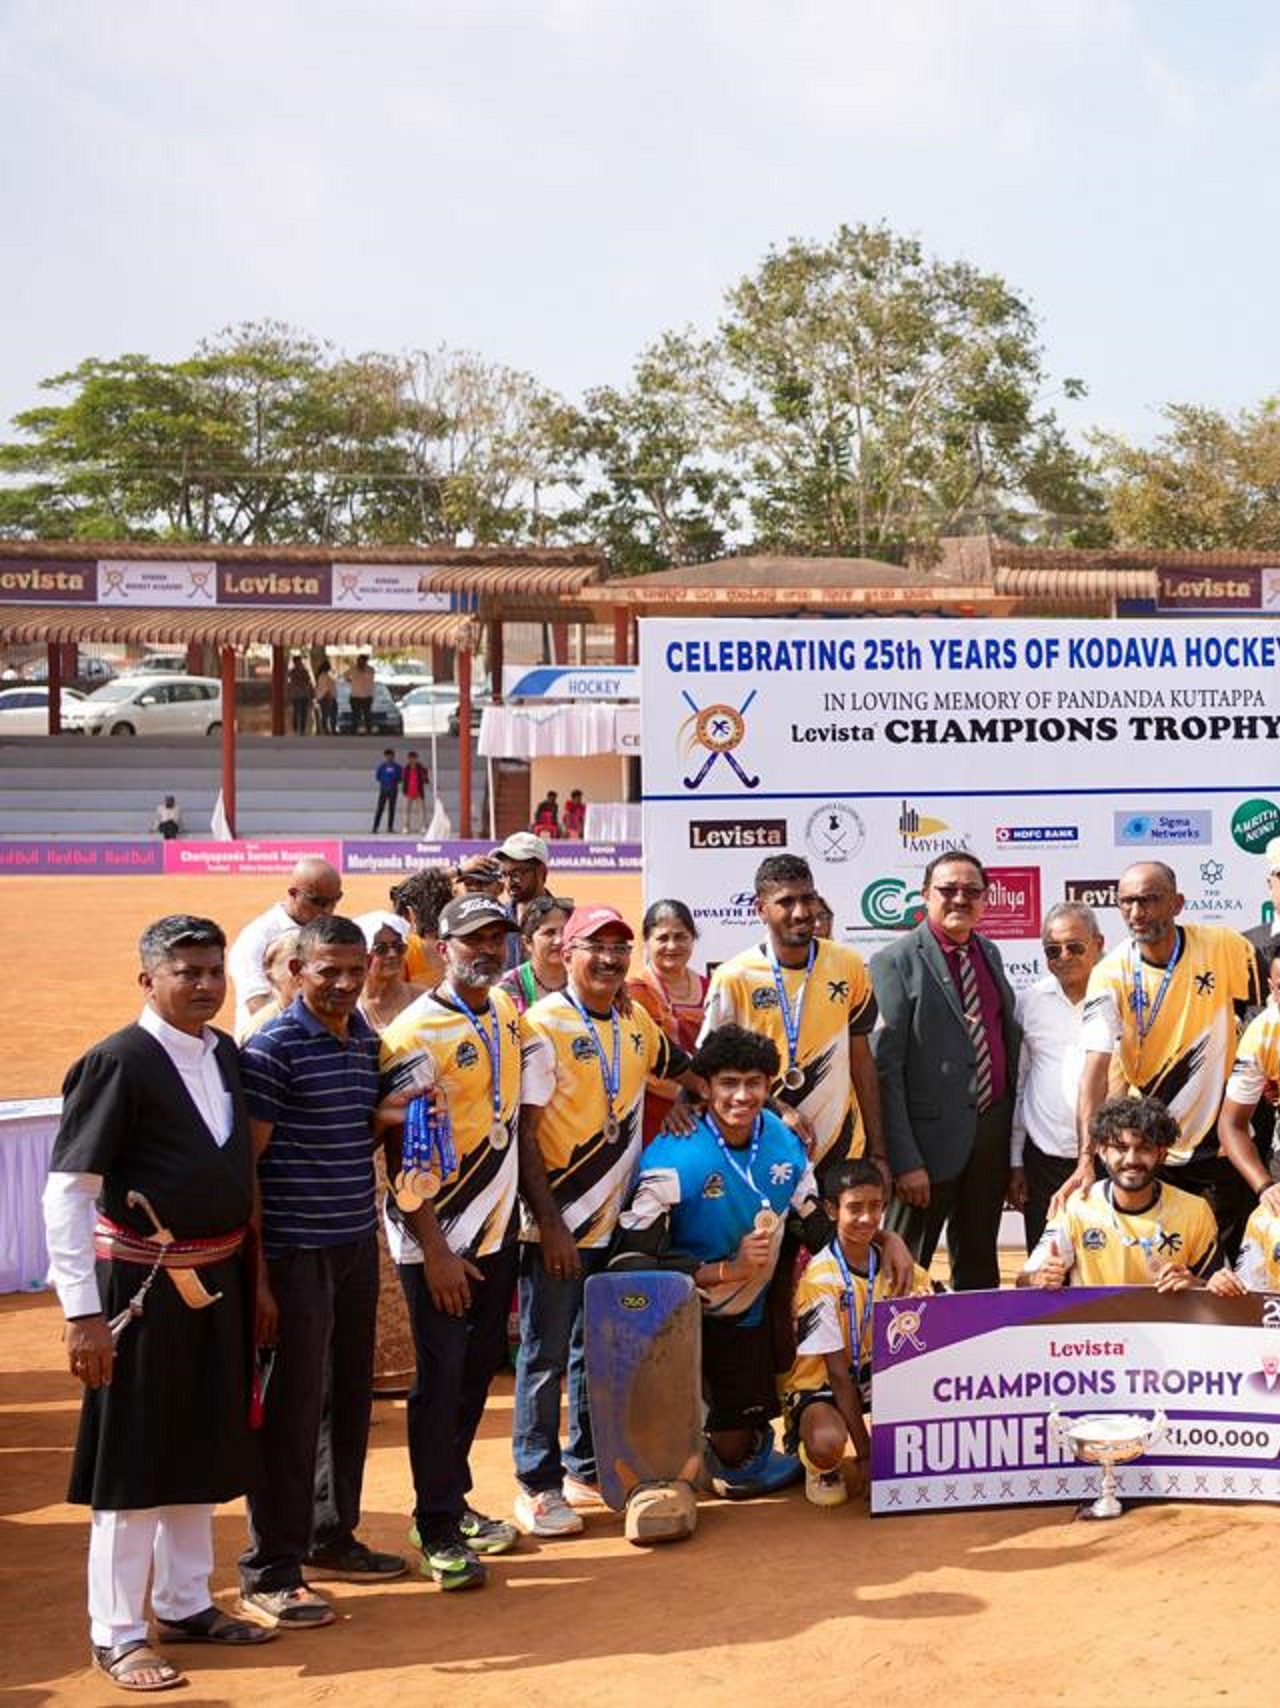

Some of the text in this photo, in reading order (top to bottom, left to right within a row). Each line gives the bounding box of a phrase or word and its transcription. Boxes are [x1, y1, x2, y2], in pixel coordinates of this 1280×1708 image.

[0, 569, 84, 590] evista
[225, 574, 319, 594] Levista
[1166, 579, 1251, 598] Levista
[666, 640, 855, 672] CELEBRATING
[864, 639, 922, 670] 25th
[929, 639, 1017, 670] YEARS
[1025, 638, 1059, 669] OF
[1068, 637, 1177, 669] KODAVA
[569, 680, 621, 694] HOCKEY
[824, 689, 1266, 711] IN LOVING MEMORY OF PANDANDA KUTTAPPA
[791, 723, 875, 743] Levista
[885, 717, 1118, 743] CHAMPIONS
[1159, 816, 1190, 829] Sigma
[692, 826, 781, 846] Levista
[1044, 829, 1075, 839] BANK
[1151, 828, 1200, 839] Networks
[909, 837, 968, 853] MYHNA
[1050, 1340, 1125, 1358] Levista
[933, 1370, 1244, 1402] CHAMPIONS TROPHY
